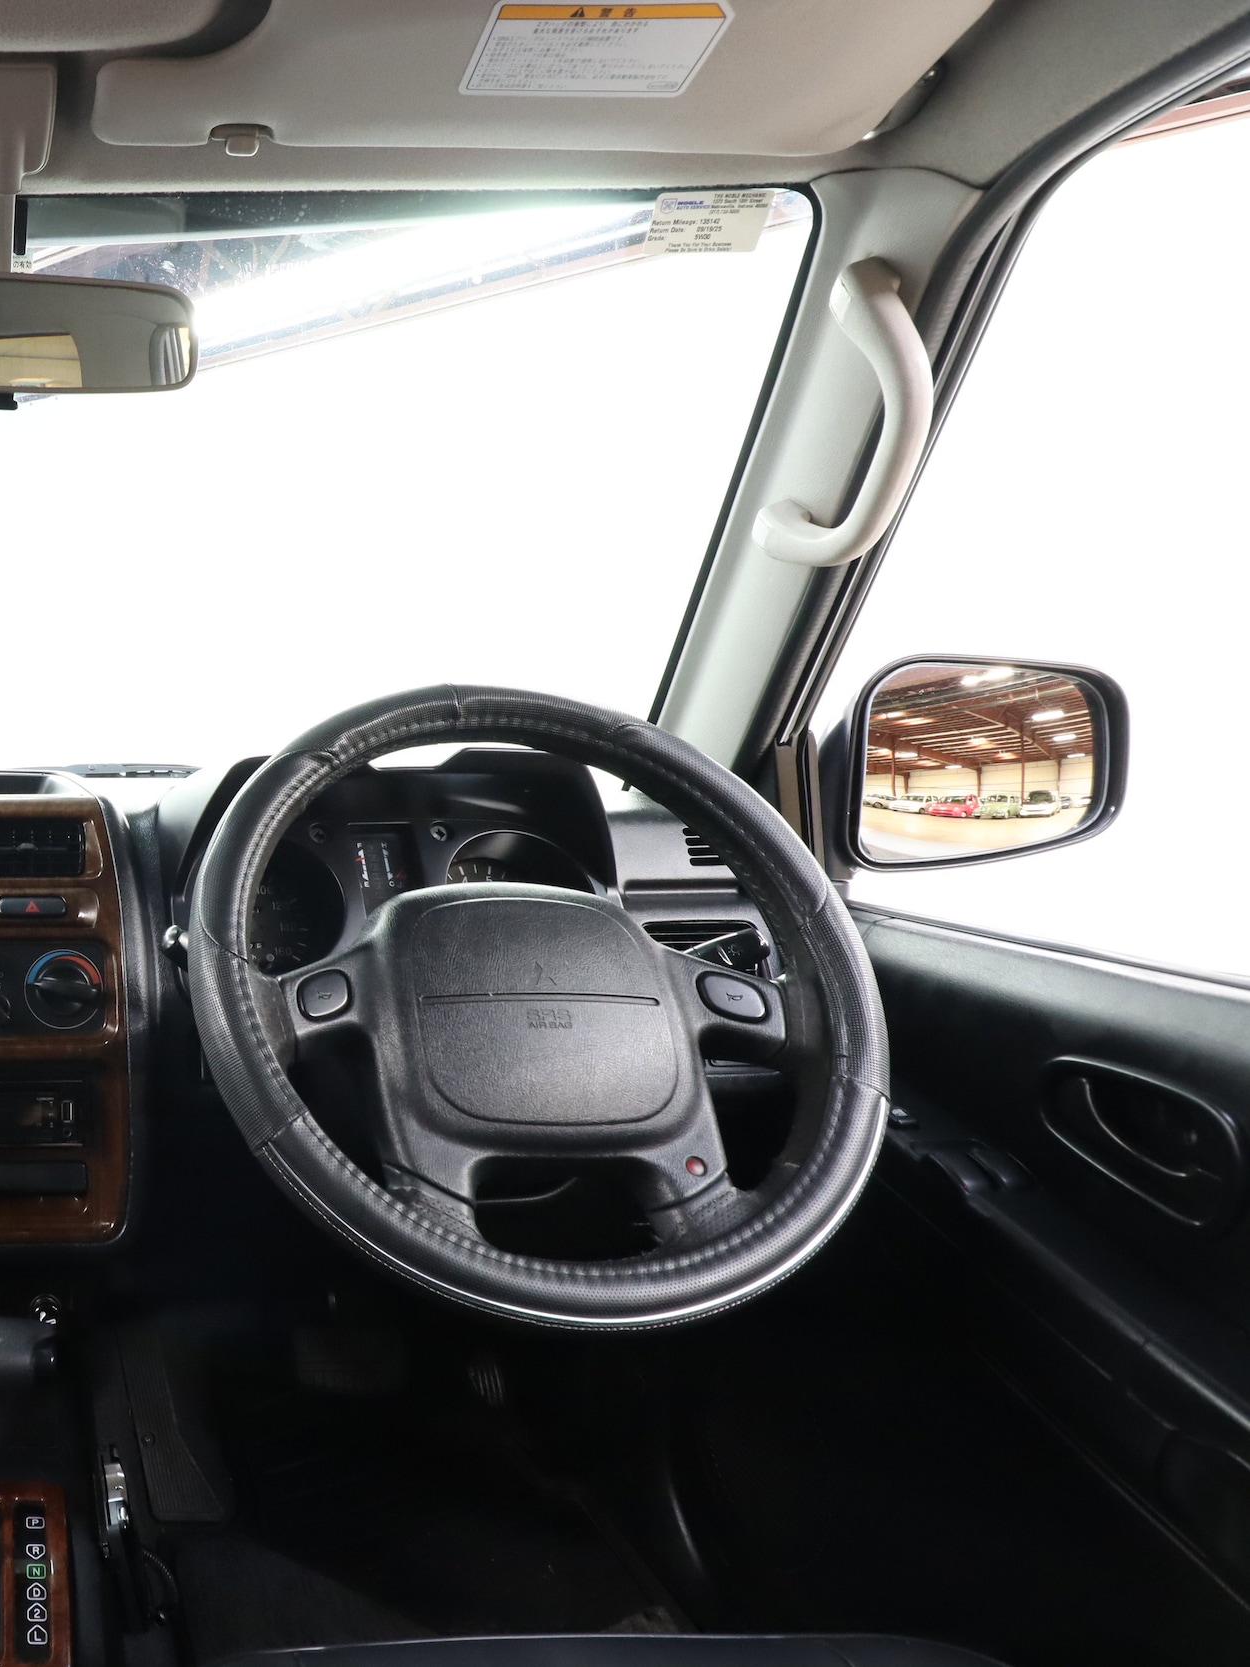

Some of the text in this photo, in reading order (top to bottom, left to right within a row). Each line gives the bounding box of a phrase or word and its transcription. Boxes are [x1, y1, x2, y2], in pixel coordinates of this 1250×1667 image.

[599, 7, 638, 17] 警告
[32, 1546, 40, 1555] R
[32, 1567, 40, 1576] N
[33, 1587, 41, 1598] D
[33, 1608, 41, 1619] 2
[34, 1630, 42, 1641] L
